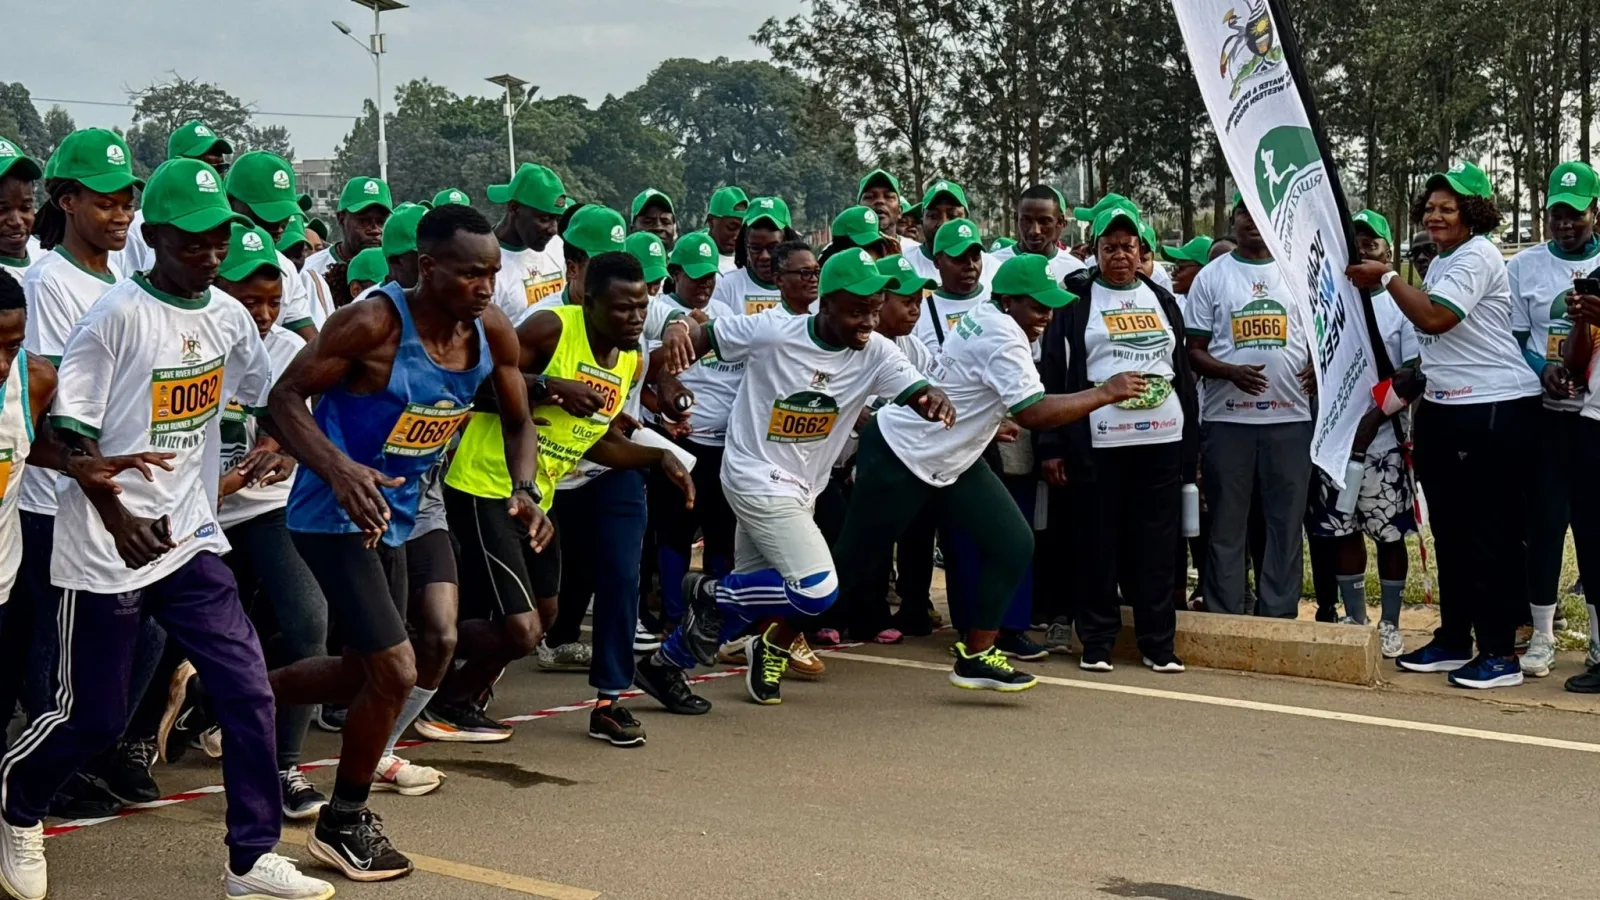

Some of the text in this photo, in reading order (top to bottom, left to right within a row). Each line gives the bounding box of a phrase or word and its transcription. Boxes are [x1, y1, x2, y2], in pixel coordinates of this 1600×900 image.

[1115, 315, 1157, 331] 0150
[1242, 318, 1281, 337] 0566
[171, 374, 218, 415] 0082
[406, 420, 460, 443] 0687
[782, 415, 829, 434] 0662
